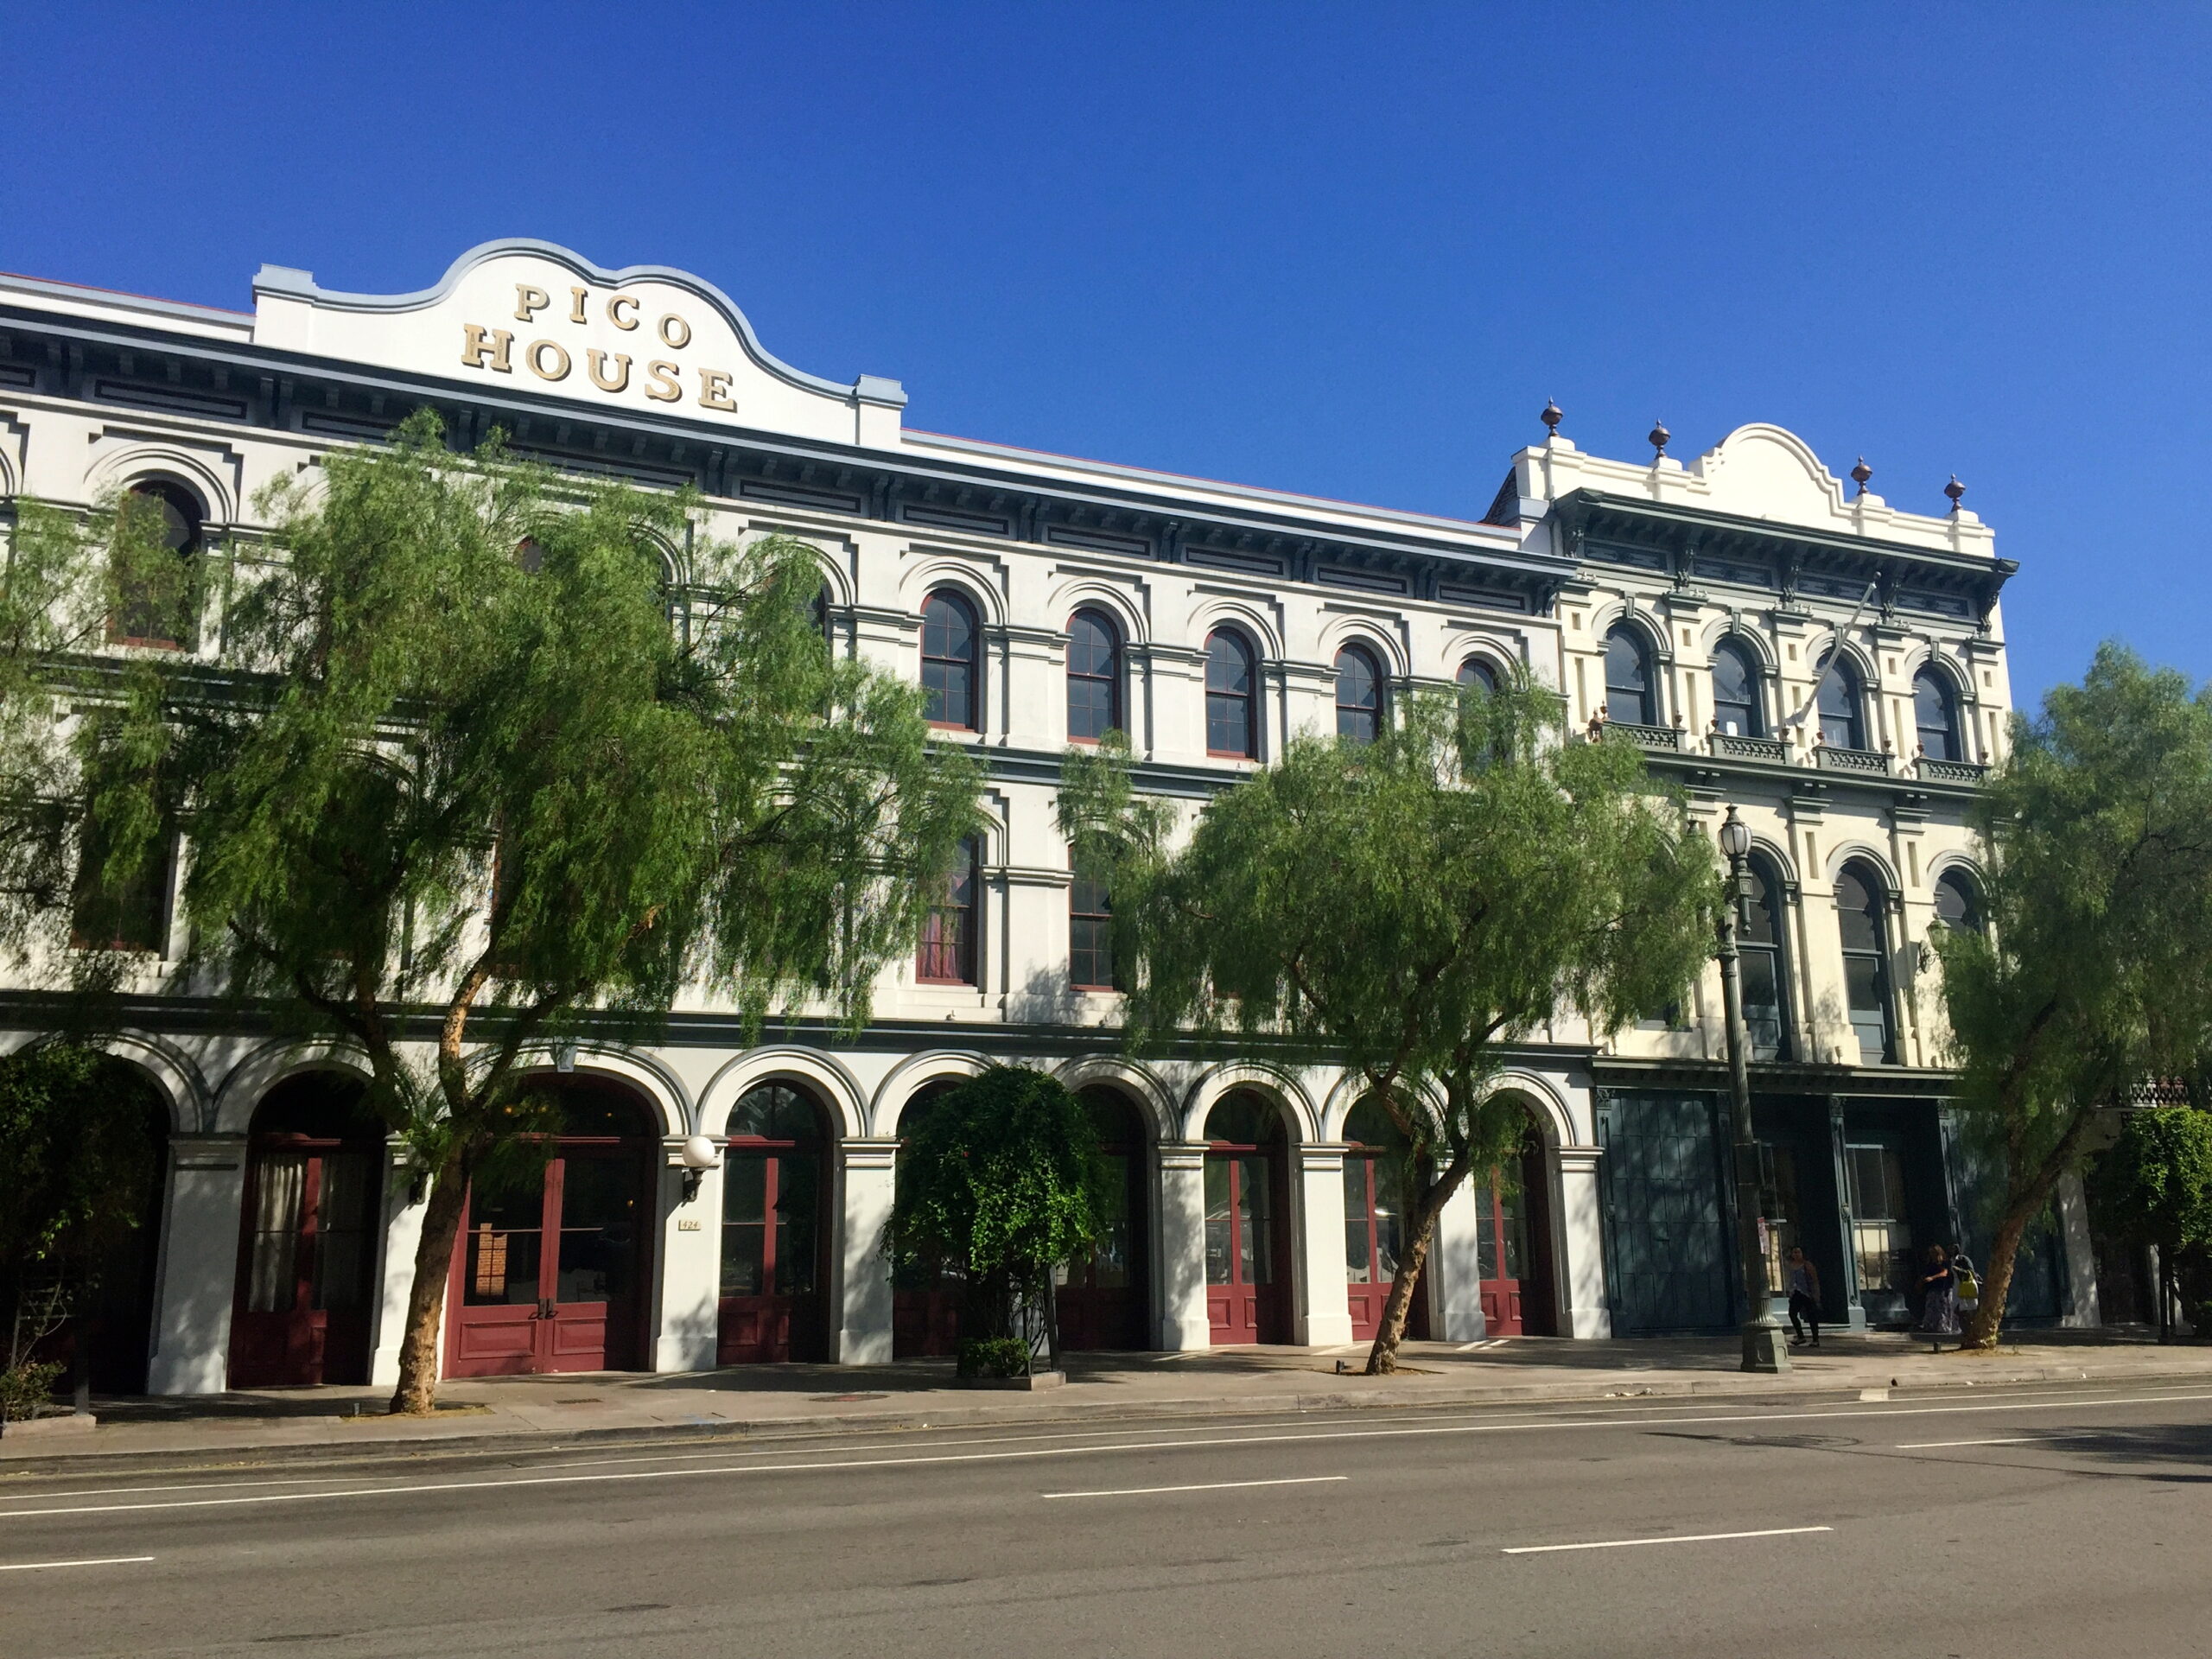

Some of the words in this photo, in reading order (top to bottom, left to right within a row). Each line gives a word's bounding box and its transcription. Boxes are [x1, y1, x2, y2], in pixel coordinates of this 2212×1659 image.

[514, 283, 691, 349] PICO
[461, 323, 737, 413] HOUSE
[683, 1220, 699, 1230] 424
